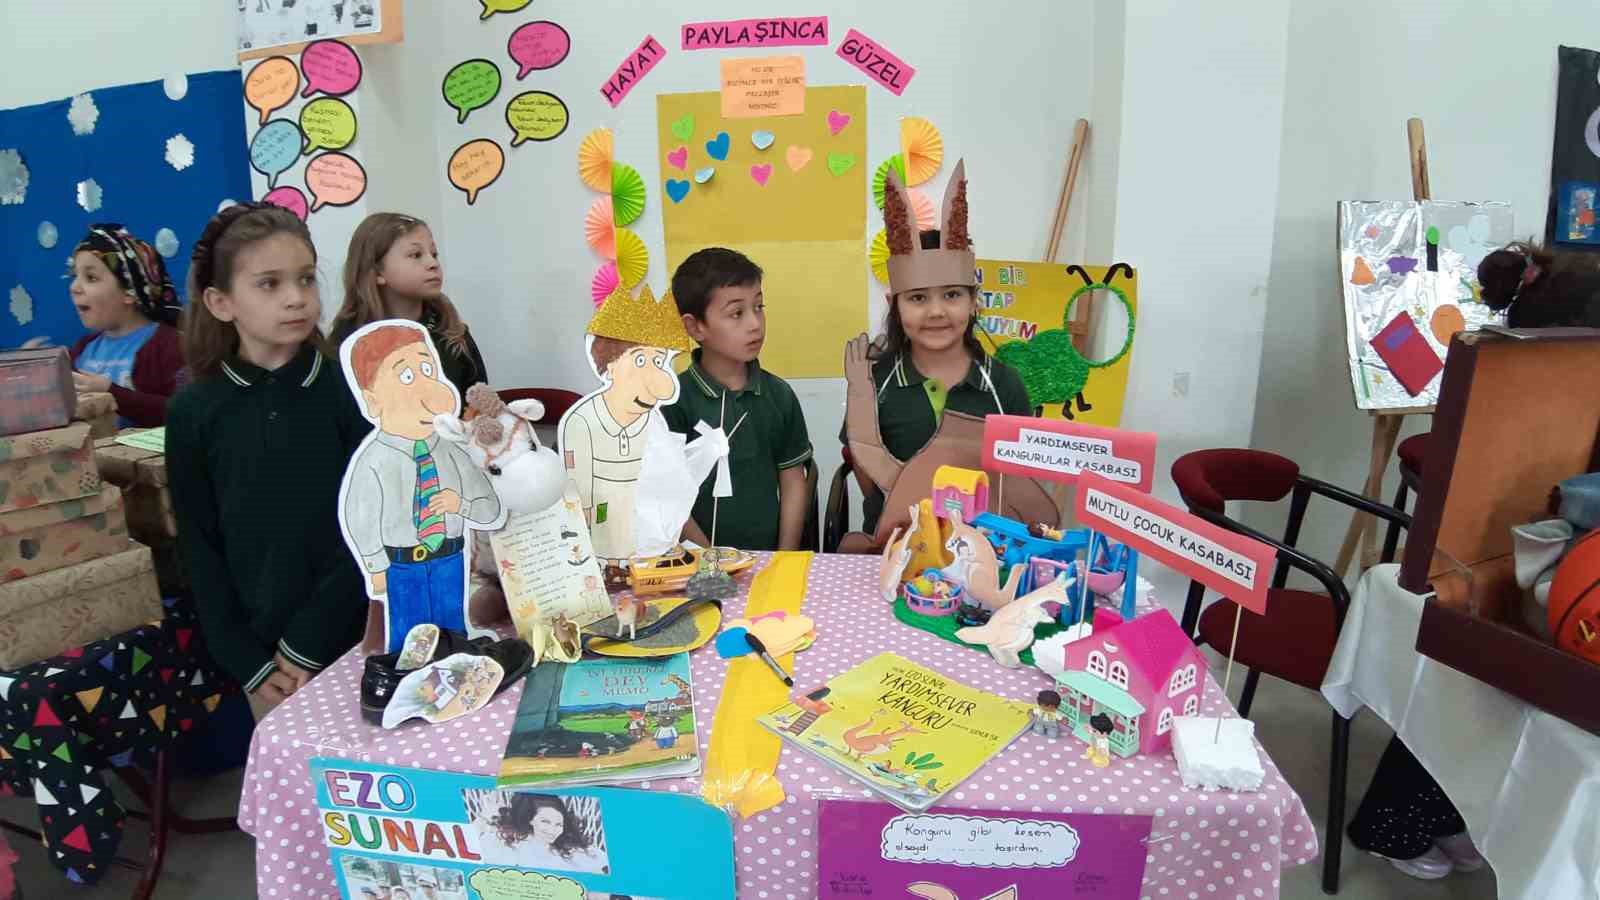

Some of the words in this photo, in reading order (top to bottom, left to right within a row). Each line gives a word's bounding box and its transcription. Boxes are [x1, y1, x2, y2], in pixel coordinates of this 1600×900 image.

[601, 39, 660, 103] HAYAT
[684, 21, 826, 45] PAYLAŞINCA
[841, 38, 902, 90] GÜZEL
[996, 447, 1070, 467] KANGURULAR
[1074, 459, 1137, 478] KASABASI
[1025, 434, 1108, 456] YARDIMSEVER
[1088, 495, 1130, 522] MUTLU
[1133, 515, 1175, 544] ÇOCUK
[1179, 534, 1254, 581] KASABASI
[878, 690, 953, 730] KANGURU
[880, 672, 977, 717] YARDIMSEVER
[325, 770, 415, 812] EZO
[324, 812, 482, 861] SUNAL
